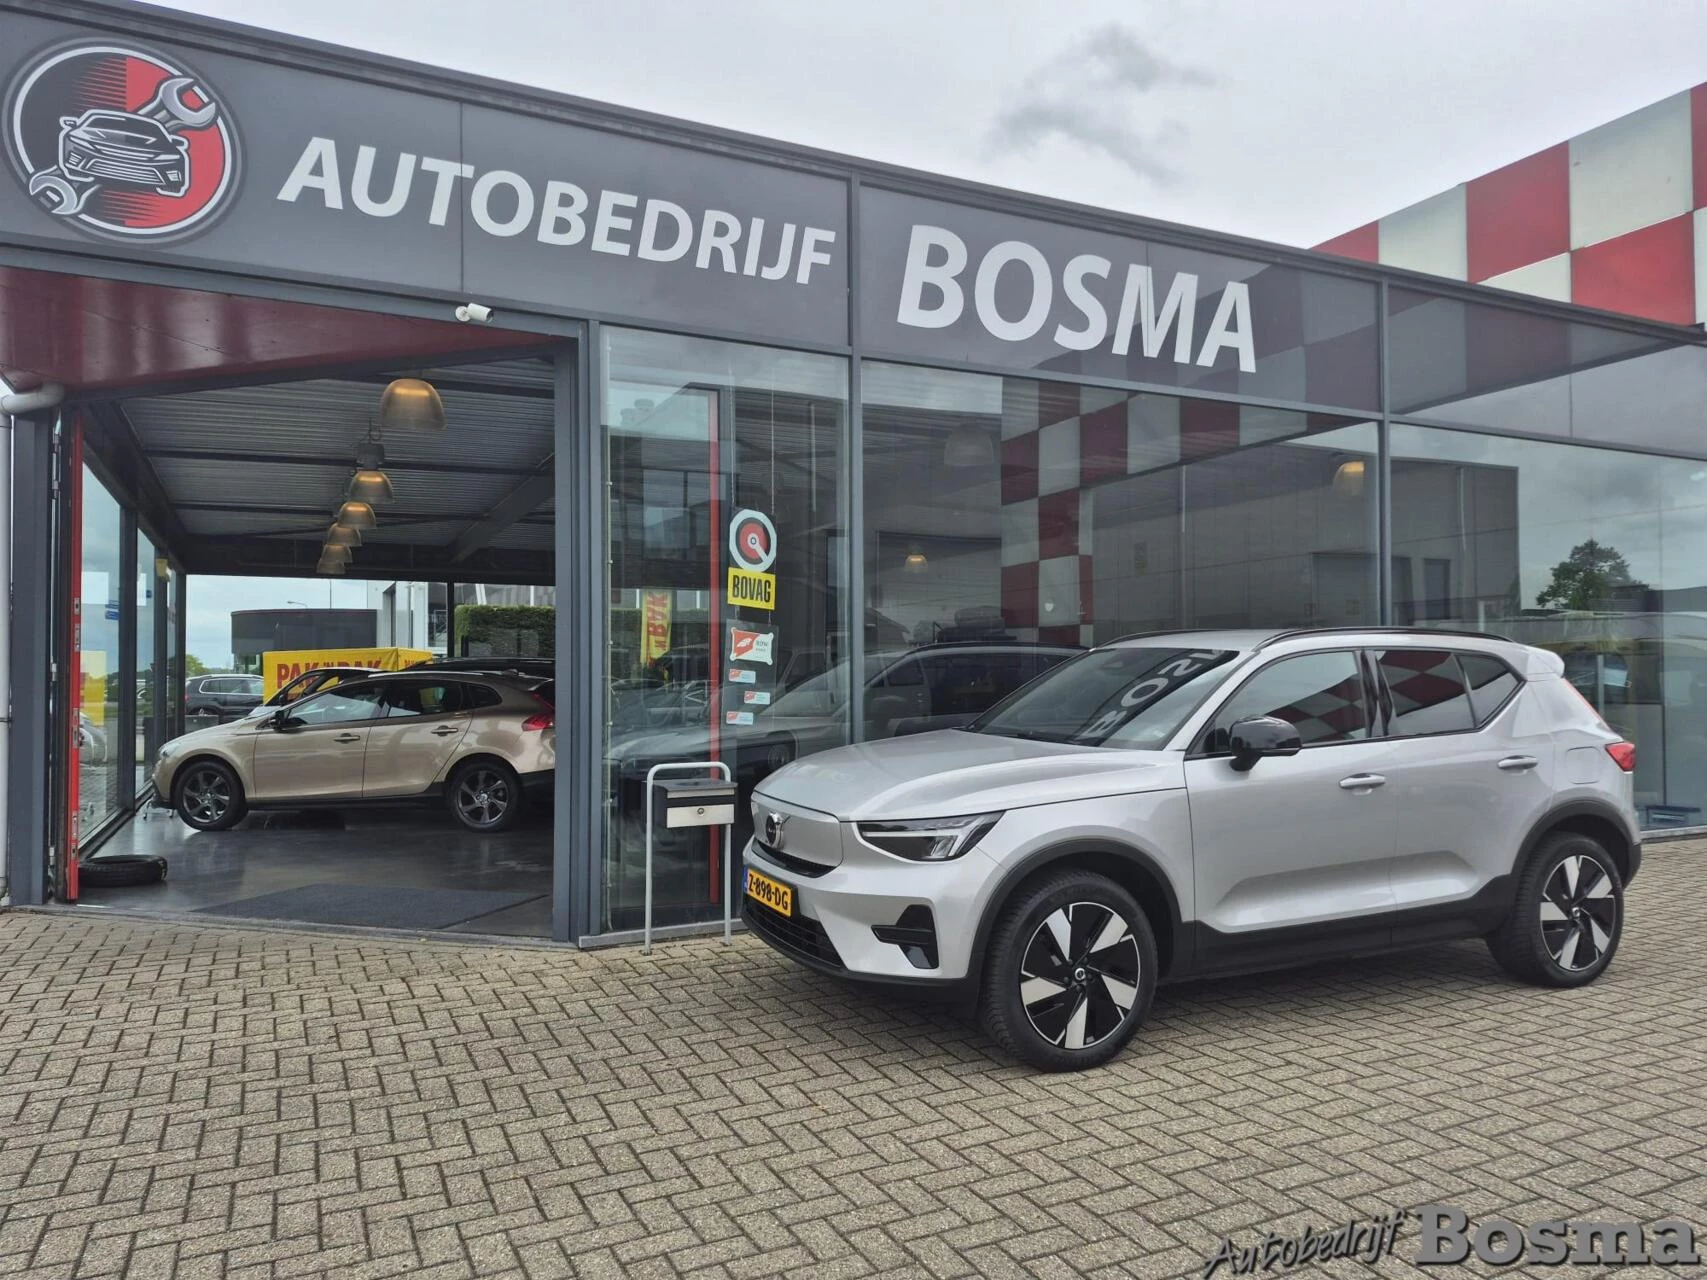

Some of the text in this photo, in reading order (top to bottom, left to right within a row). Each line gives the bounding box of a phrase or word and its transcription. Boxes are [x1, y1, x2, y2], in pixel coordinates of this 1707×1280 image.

[277, 136, 1256, 373] AUTOBEDRIJF BOSMA
[733, 574, 771, 603] BOVAG
[749, 873, 788, 911] Z-898-DG
